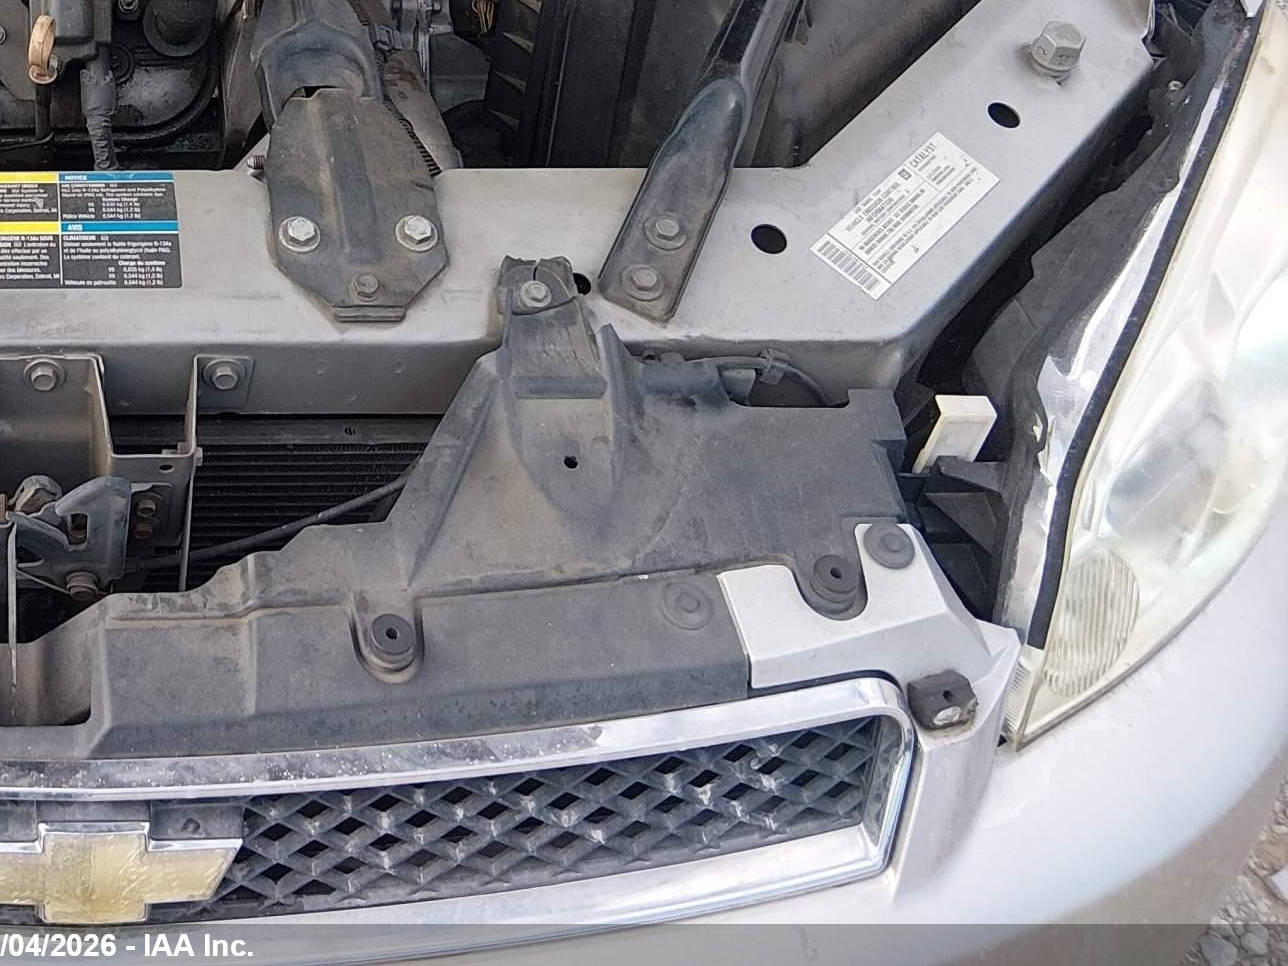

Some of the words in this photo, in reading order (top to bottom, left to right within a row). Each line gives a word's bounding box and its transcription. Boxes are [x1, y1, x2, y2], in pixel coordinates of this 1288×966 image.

[909, 143, 936, 168] CATALYST
[846, 215, 864, 232] VEHICLE
[862, 197, 882, 216] EMISSION
[880, 182, 900, 199] CONTROL
[866, 197, 893, 222] INFORMATION
